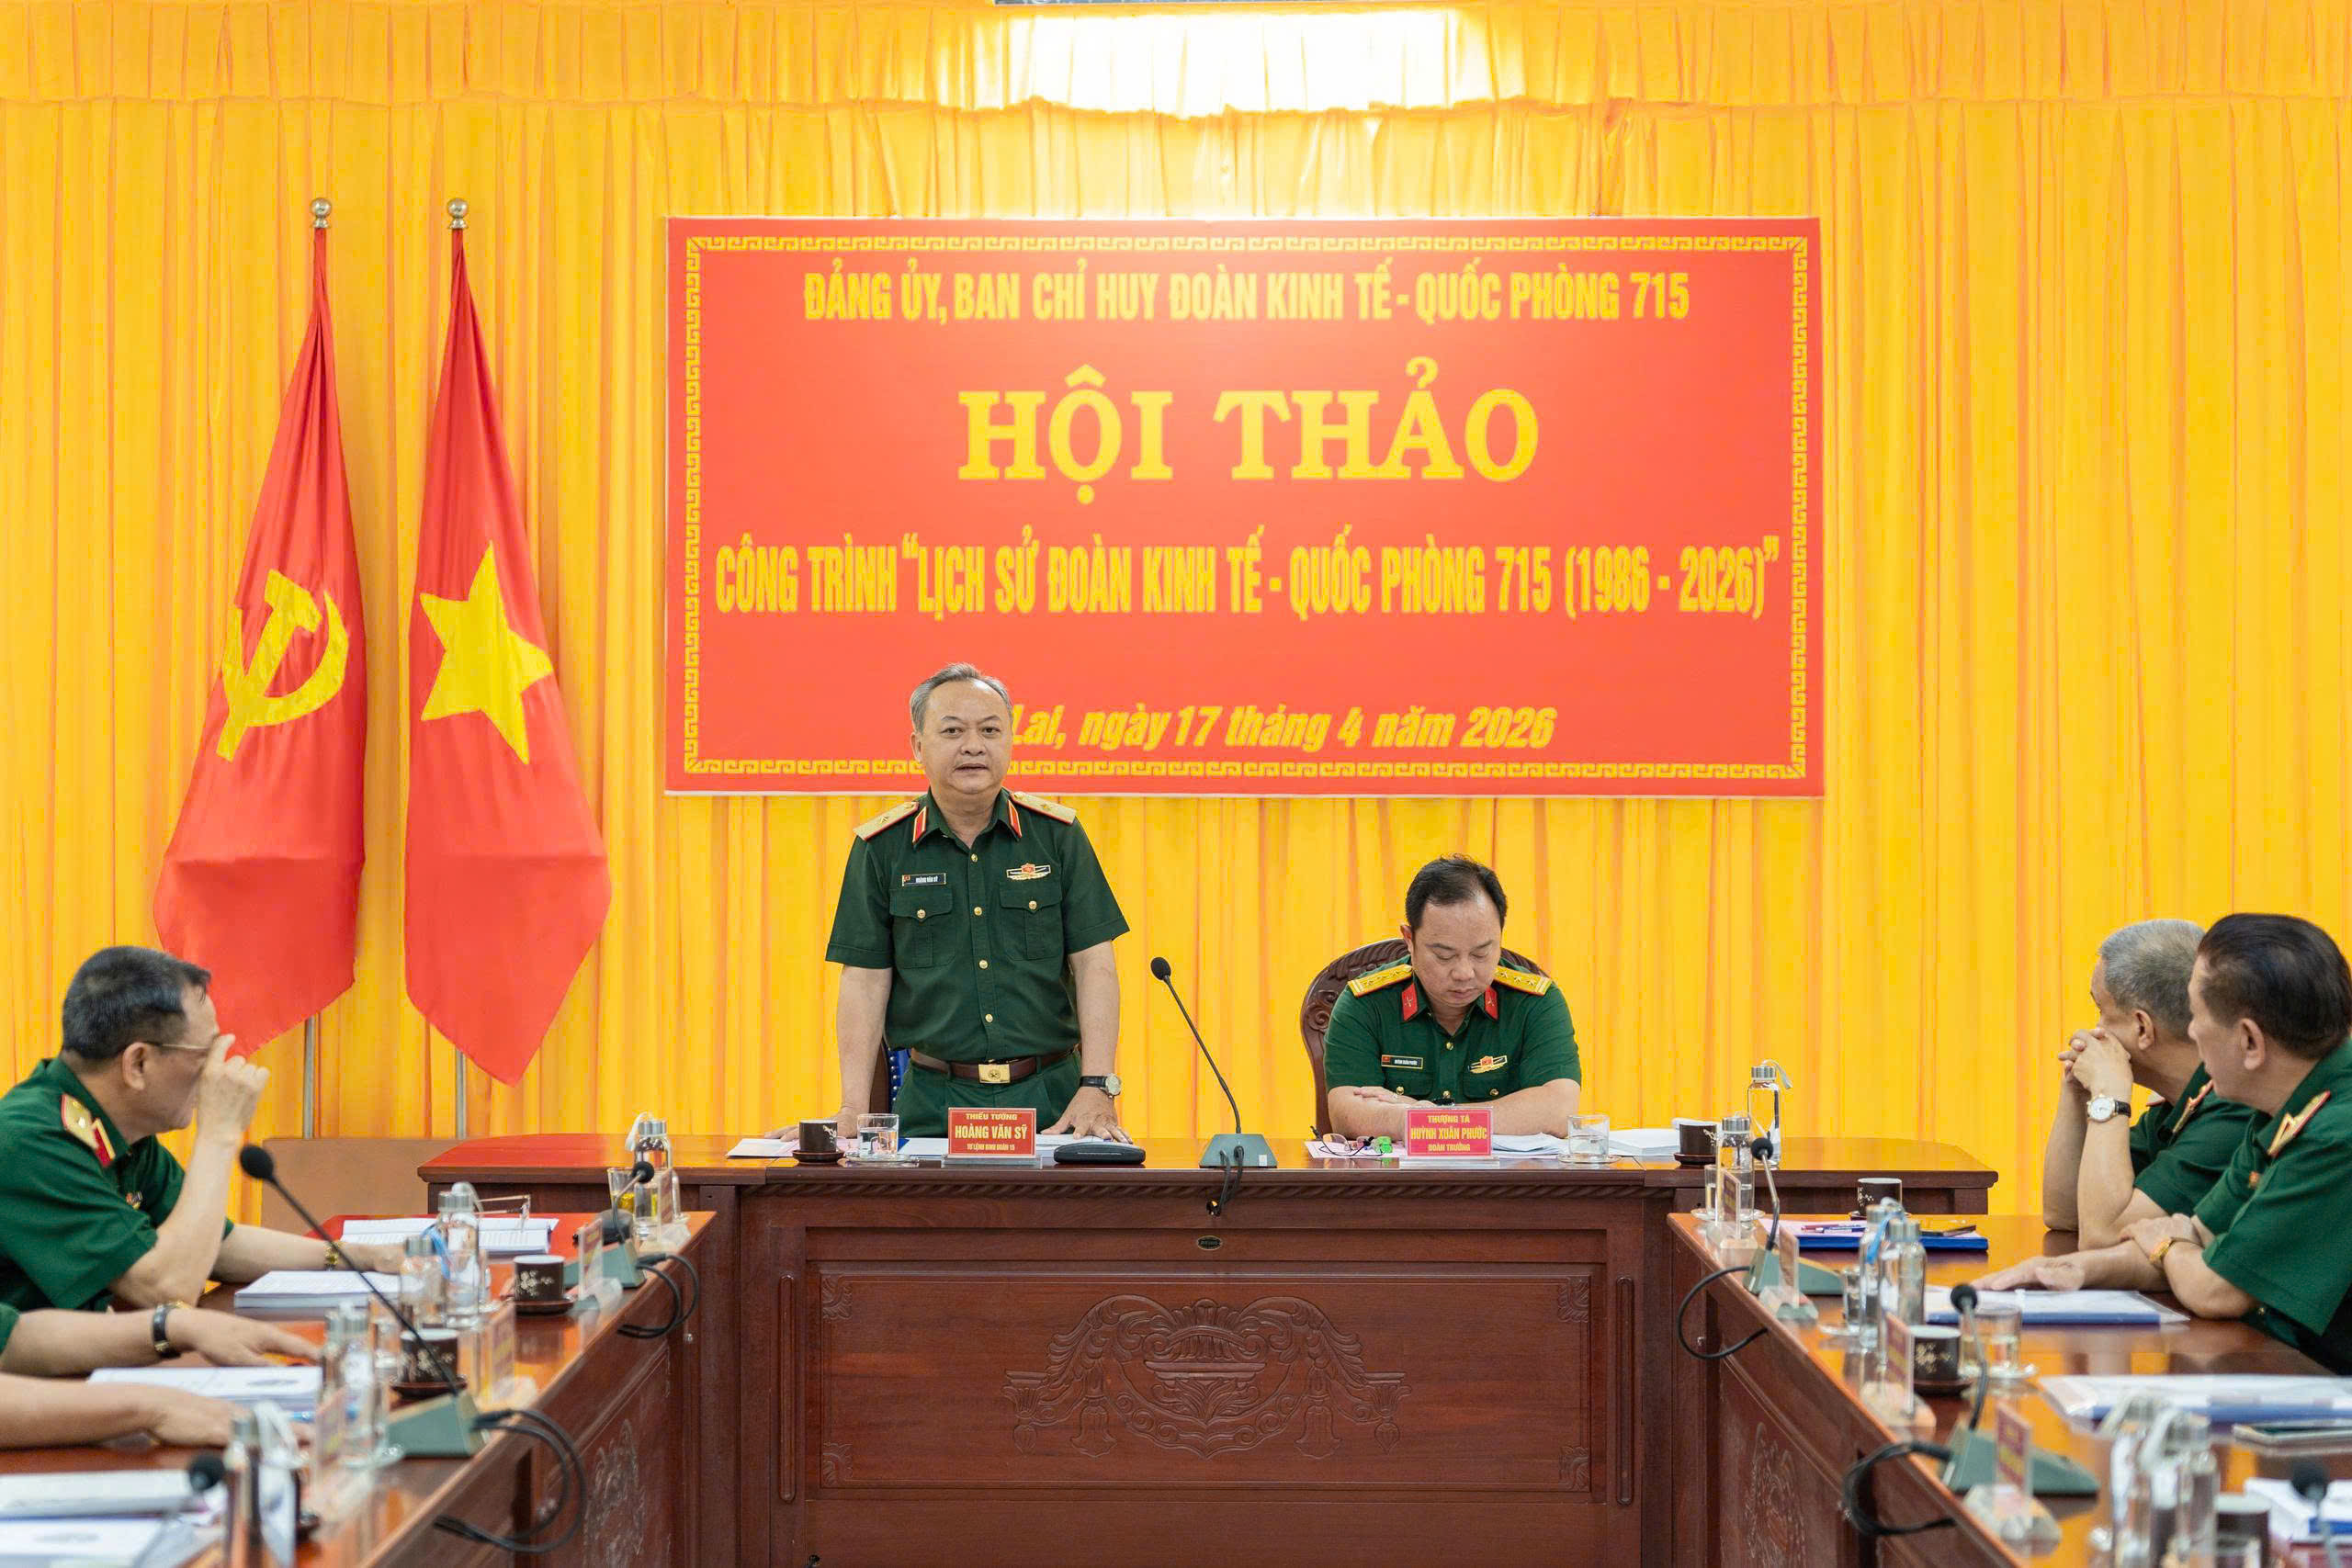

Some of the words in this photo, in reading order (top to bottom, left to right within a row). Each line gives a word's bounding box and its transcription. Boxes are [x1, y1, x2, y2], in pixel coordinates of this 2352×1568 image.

[804, 257, 892, 321] ĐẢNG
[900, 257, 948, 325] ỦY,
[954, 272, 1020, 321] BAN
[1032, 257, 1088, 321] CHỈ
[1096, 272, 1159, 321] HUY
[1169, 265, 1257, 321] ĐOÀN
[1267, 272, 1345, 321] KINH
[1353, 257, 1393, 320] TẾ
[1416, 257, 1503, 325] QUỐC
[1510, 262, 1621, 321] PHÒNG
[1628, 272, 1690, 321] 715
[957, 362, 1175, 505] HỘI
[1213, 355, 1540, 483] THẢO
[715, 532, 799, 615] CÔNG
[808, 532, 897, 615] TRÌNH
[901, 533, 986, 622] “LỊCH
[994, 524, 1040, 614] SỬ
[1047, 533, 1133, 614] ĐOÀN
[1142, 546, 1216, 615] KINH
[1226, 524, 1264, 615] TẾ
[1288, 524, 1373, 622] QUỐC
[1381, 533, 1486, 615] PHÒNG
[1495, 545, 1552, 614] 715
[1565, 545, 1650, 620] (1986
[1678, 535, 1780, 620] 2026)”
[1078, 702, 1174, 751] ngày
[1177, 706, 1224, 747] 17
[1226, 703, 1332, 753] tháng
[1337, 707, 1364, 748] 4
[1371, 705, 1457, 748] năm
[1460, 705, 1558, 749] 2026
[956, 1123, 989, 1139] HOÀNG
[991, 1124, 1012, 1139] VĂN
[1014, 1124, 1027, 1139] SỸ
[1439, 1126, 1459, 1139] XUÂN
